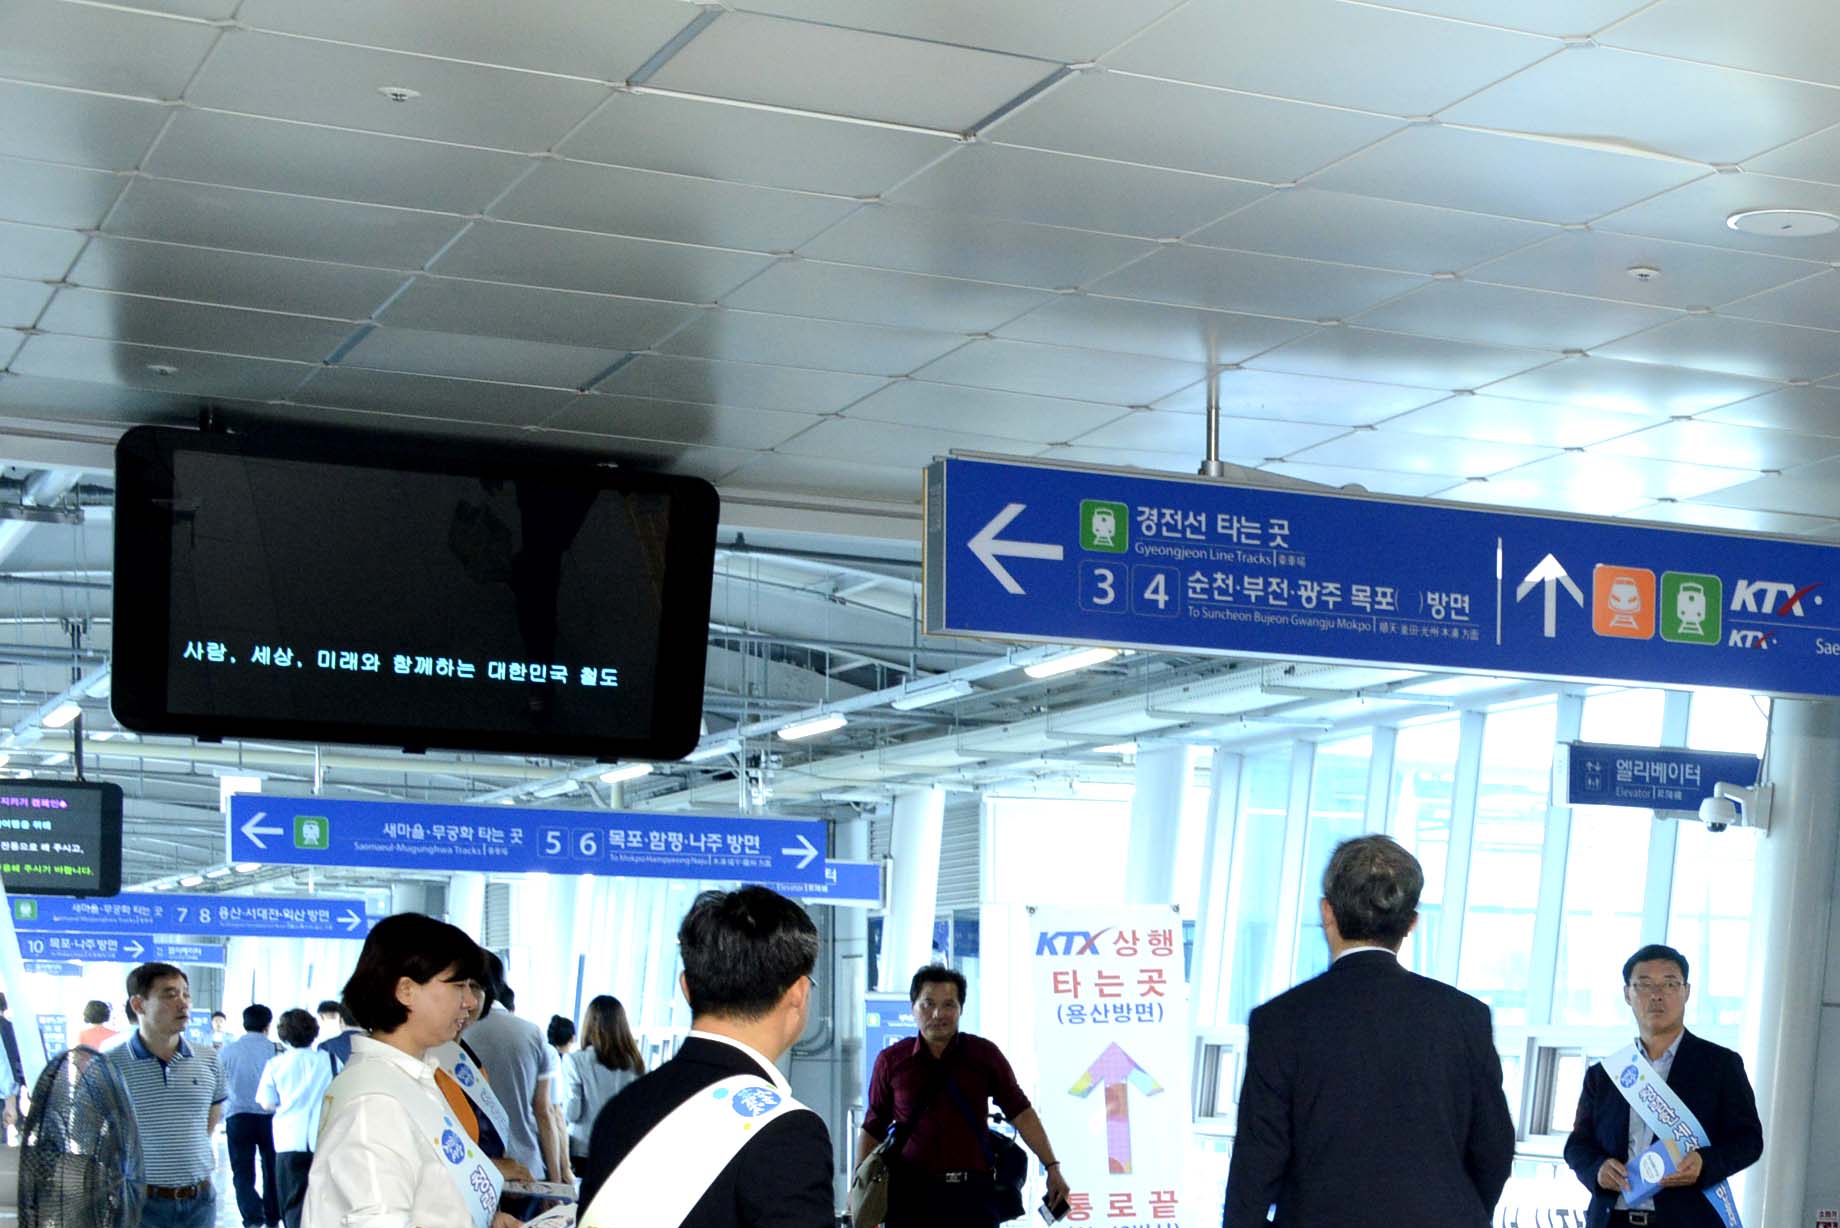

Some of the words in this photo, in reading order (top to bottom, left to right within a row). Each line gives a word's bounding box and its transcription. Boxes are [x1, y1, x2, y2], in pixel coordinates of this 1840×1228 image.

[1136, 505, 1207, 541] 경전선
[1216, 513, 1262, 545] 타는
[1268, 518, 1291, 549] 곳
[1134, 541, 1208, 561] Gyeongjeon
[1210, 549, 1234, 563] Line
[1236, 550, 1273, 567] Tracks
[1092, 567, 1115, 605] 3
[1144, 572, 1170, 610] 4
[1188, 605, 1200, 618] To
[1201, 607, 1252, 622] Suncheon
[1254, 611, 1290, 628] Bujeon
[1291, 615, 1336, 633] Gwangju
[1337, 618, 1372, 636] Mokpo
[317, 648, 381, 673] 미래와
[393, 653, 476, 680] 함께하는
[488, 659, 569, 684] 대한민국
[579, 665, 619, 688] 철도
[1615, 758, 1701, 786] 엘리베이터
[1615, 786, 1651, 799] Elevator
[478, 827, 505, 844] 타는
[510, 828, 524, 845] 곳
[545, 830, 562, 855] 5
[579, 832, 598, 856] 6
[726, 833, 761, 855] 방면
[176, 906, 189, 923] 7
[199, 907, 211, 923] 8
[306, 908, 330, 923] 방면
[27, 939, 44, 954] 10
[1035, 926, 1113, 956] KTX
[1056, 1002, 1164, 1025] (용산방면)
